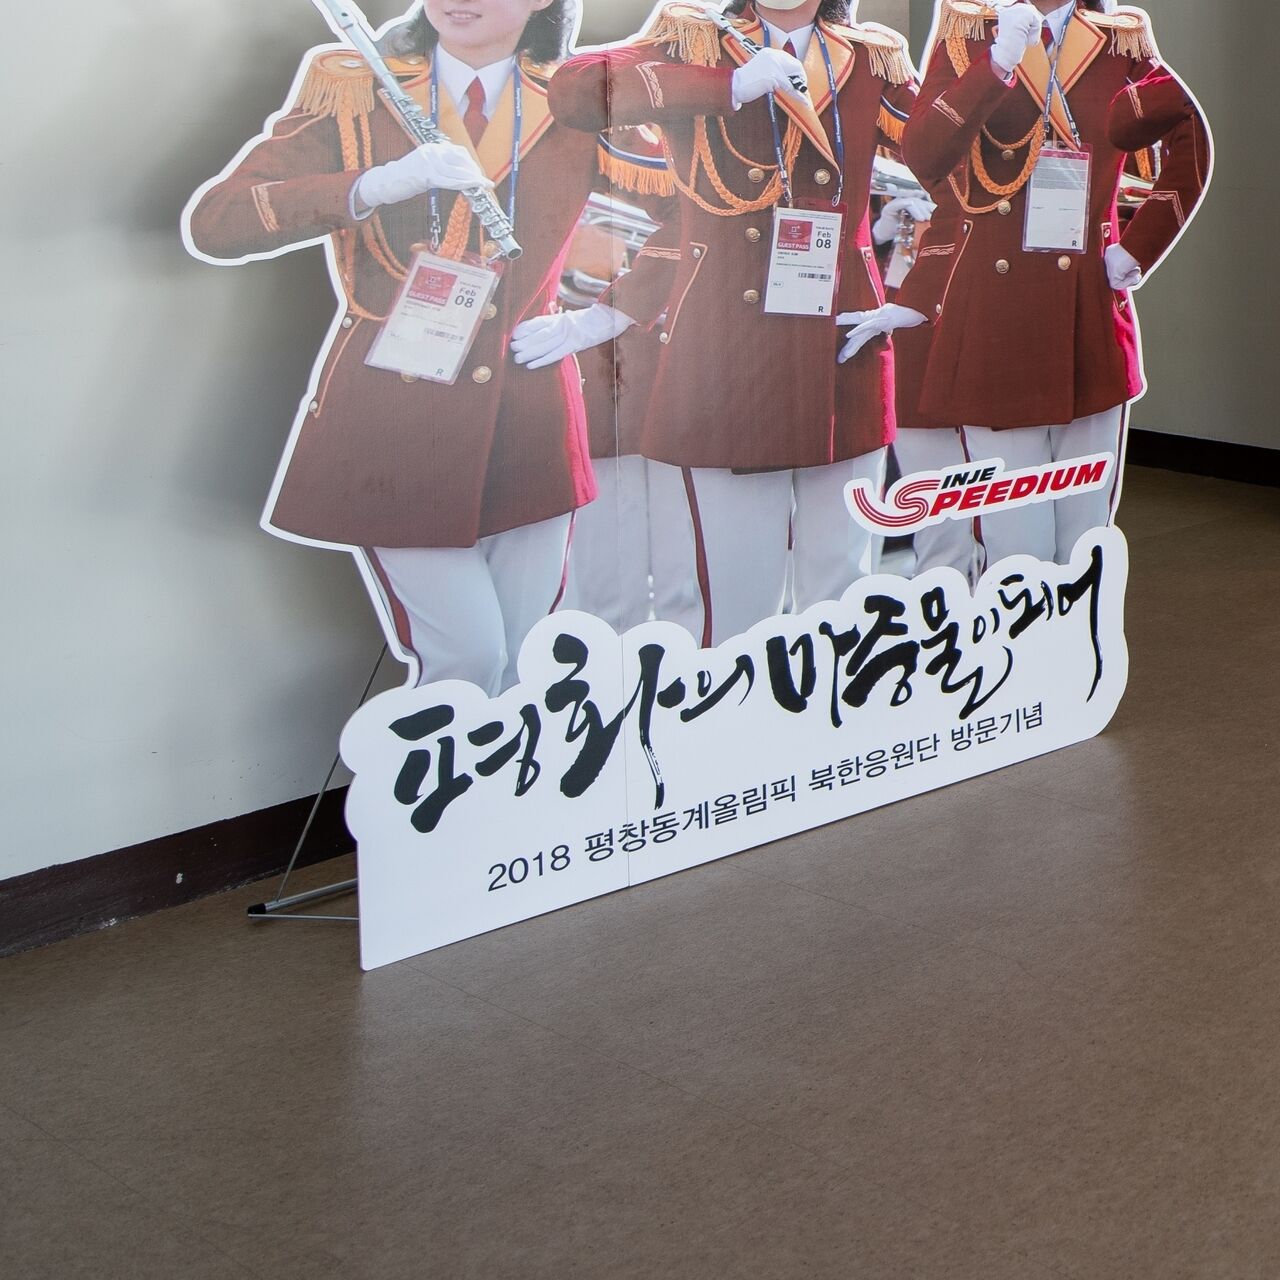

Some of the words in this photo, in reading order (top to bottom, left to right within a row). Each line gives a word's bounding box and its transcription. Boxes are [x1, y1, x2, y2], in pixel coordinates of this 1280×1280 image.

[816, 239, 832, 249] 08
[454, 295, 474, 308] 08
[853, 460, 1108, 527] SPEEDIUM
[941, 466, 996, 489] INJE
[388, 634, 754, 833] 평화의
[488, 844, 571, 891] 2018
[584, 775, 796, 864] 평창동계올림픽
[807, 732, 940, 793] 북한응원단
[950, 701, 1044, 749] 방문기념
